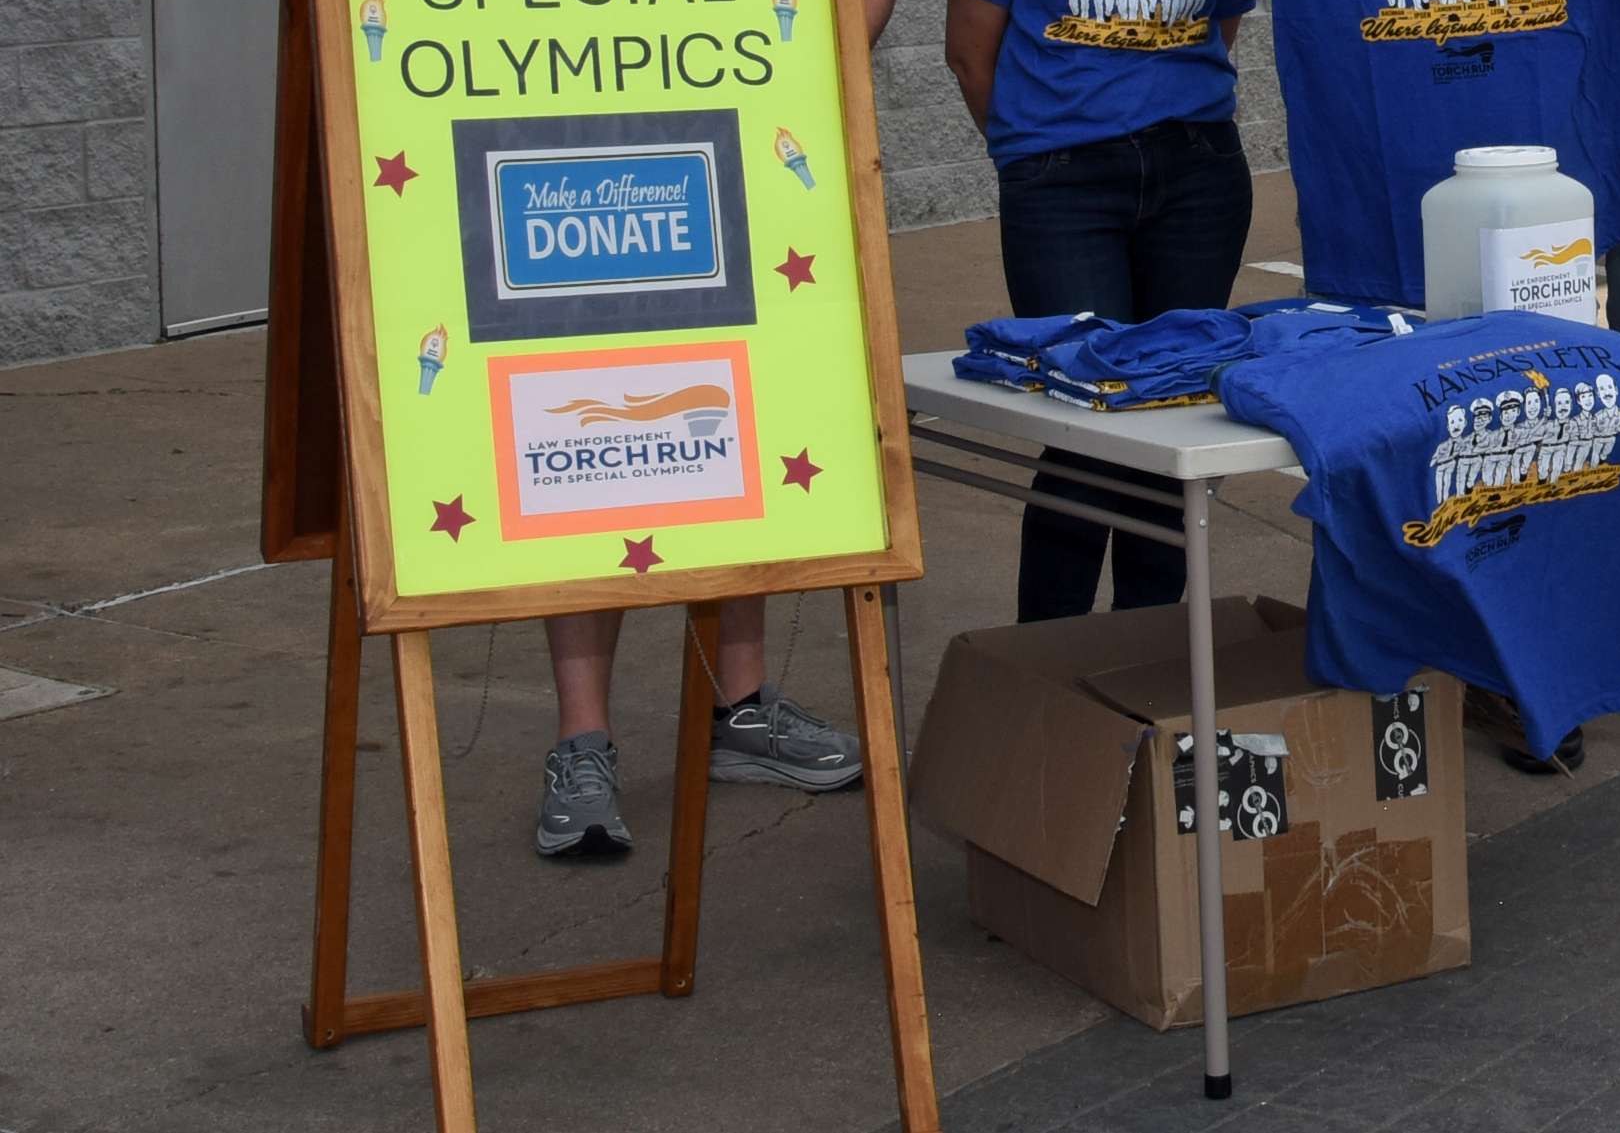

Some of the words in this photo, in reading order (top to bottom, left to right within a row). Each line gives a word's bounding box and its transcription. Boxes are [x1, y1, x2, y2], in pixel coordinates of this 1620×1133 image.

[1049, 22, 1099, 43] Where
[1103, 30, 1158, 49] legends
[1361, 17, 1421, 38] Where
[1425, 14, 1486, 41] legends
[1491, 18, 1521, 31] are
[1523, 6, 1567, 28] made
[400, 29, 774, 99] OLYMPICS
[523, 176, 577, 210] Make
[580, 189, 592, 207] a
[596, 174, 689, 212] Difference!
[526, 210, 692, 260] DONATE
[1509, 281, 1561, 303] TORCH
[1563, 276, 1591, 296] RUN
[1511, 279, 1525, 287] LAW
[1527, 272, 1570, 285] ENFORCEMENT
[1528, 301, 1552, 310] SPECIAL
[1411, 354, 1534, 413] KANSAS
[524, 444, 649, 474] TORCH
[657, 437, 728, 464] RUN
[528, 440, 559, 451] LAW
[564, 431, 673, 449] ENFORCEMENT
[533, 476, 562, 487] FOR
[567, 470, 628, 484] SPECIAL
[632, 463, 705, 478] OLYMPICS
